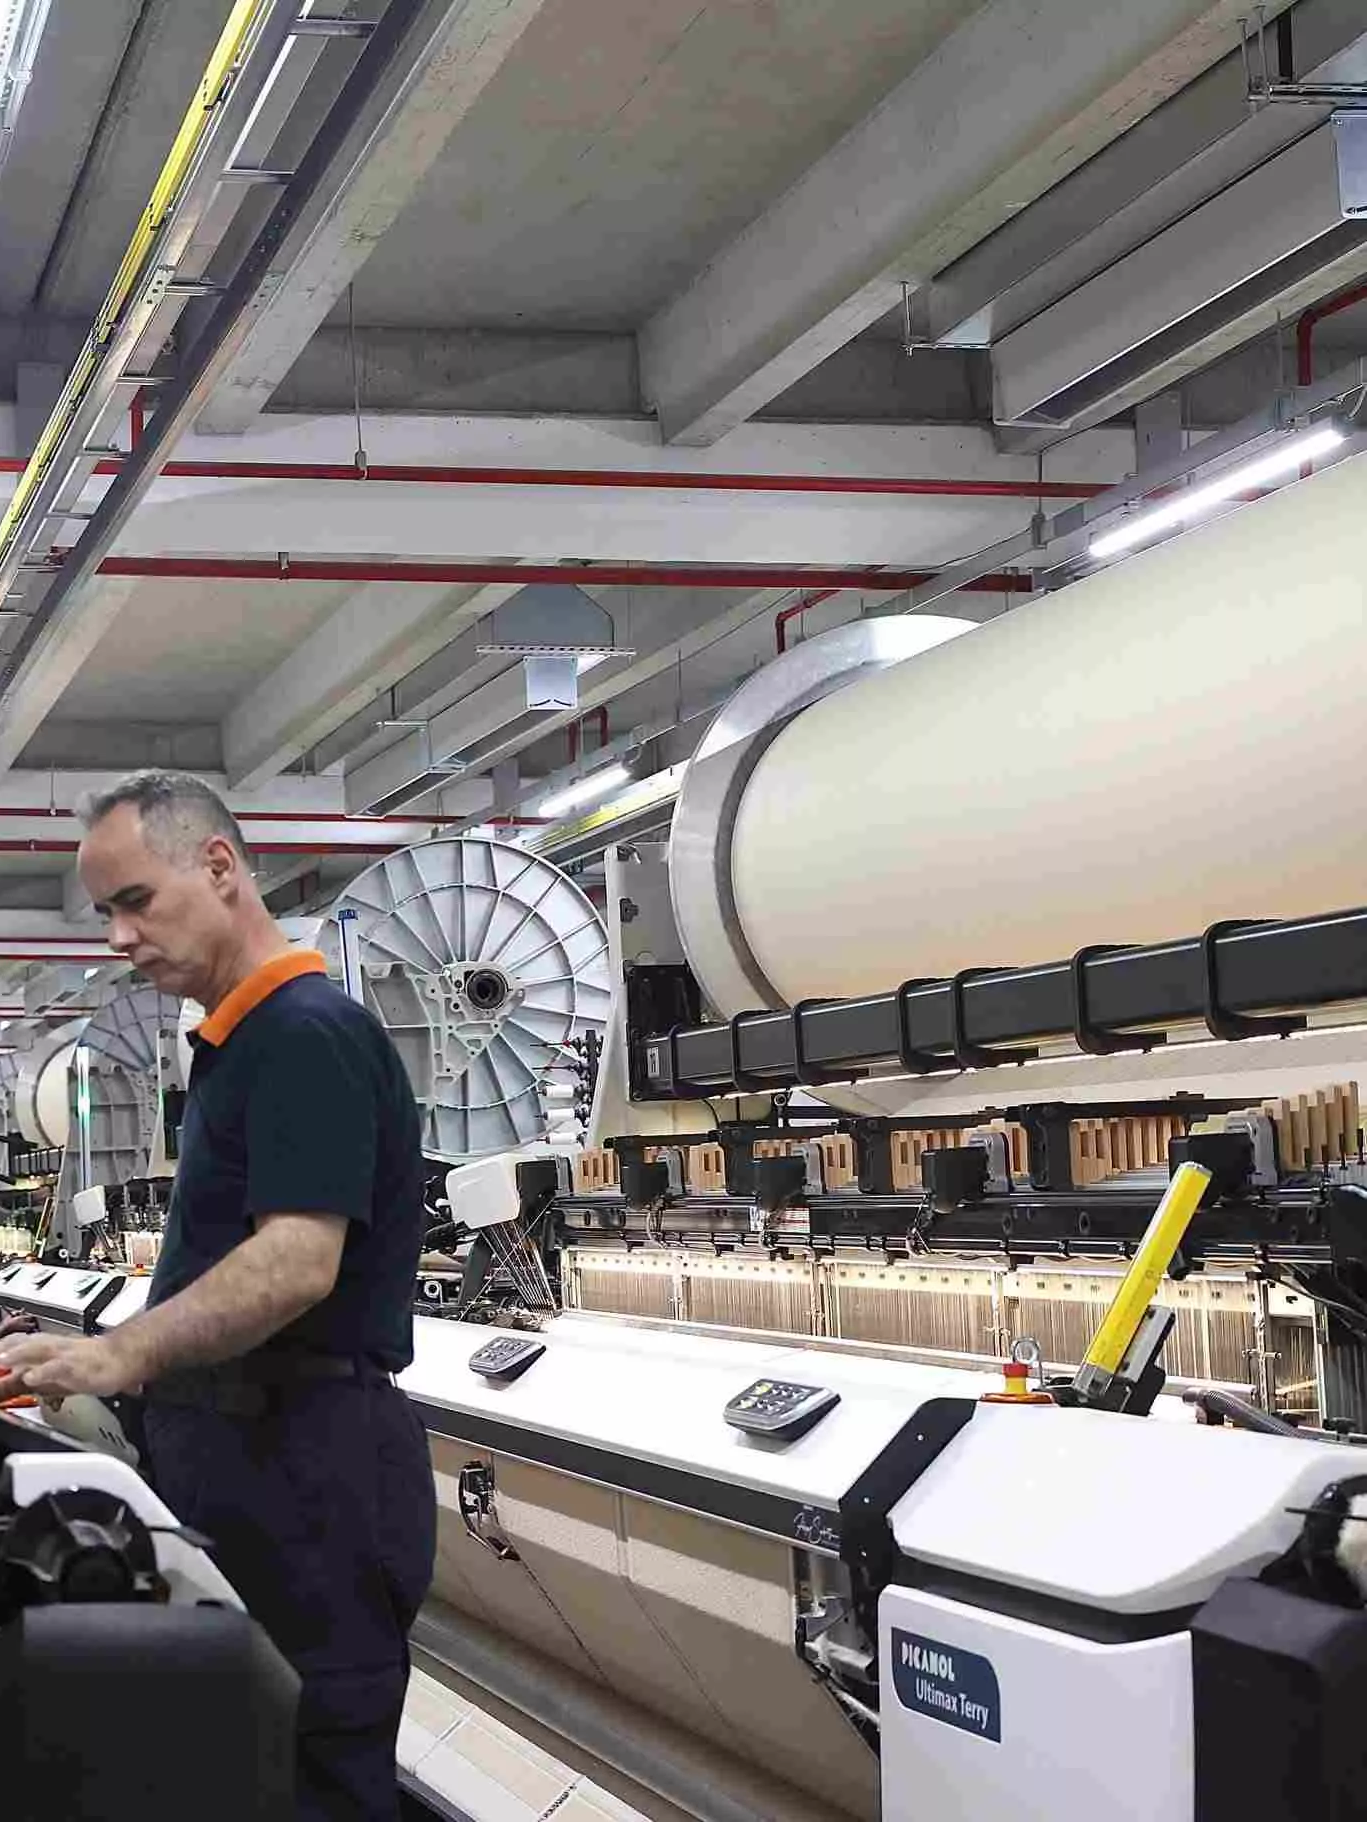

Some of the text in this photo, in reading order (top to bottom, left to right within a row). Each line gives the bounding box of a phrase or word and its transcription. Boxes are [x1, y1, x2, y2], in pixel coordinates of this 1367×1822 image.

[901, 1641, 955, 1682] PICANOL
[915, 1677, 989, 1730] Ultimax Terry
